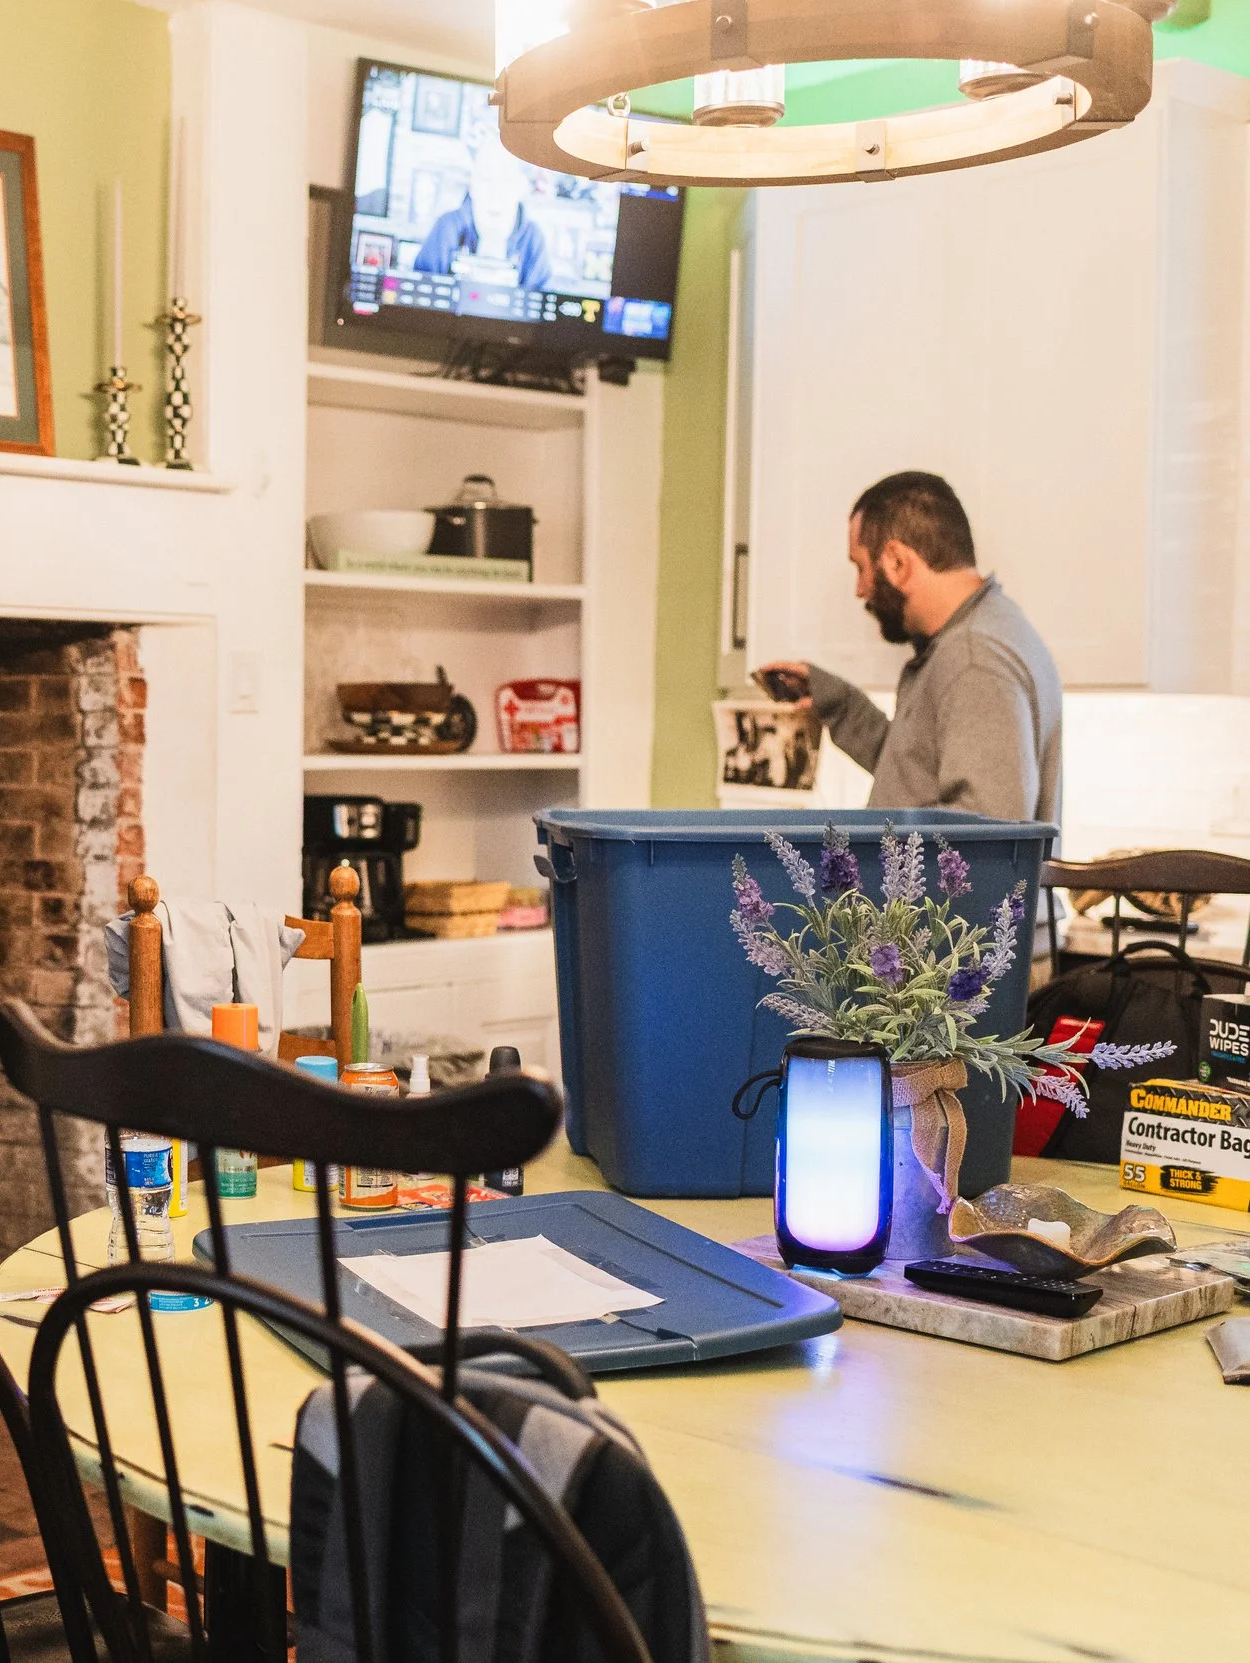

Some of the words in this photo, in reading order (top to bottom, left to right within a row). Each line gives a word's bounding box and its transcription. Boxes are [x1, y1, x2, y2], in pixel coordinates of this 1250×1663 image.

[1210, 1018, 1250, 1042] DUDE
[1209, 1036, 1249, 1057] WIPES
[1130, 1088, 1232, 1121] COMMANDER
[1128, 1116, 1216, 1148] Contractor
[1125, 1140, 1141, 1150] Heavy
[1142, 1142, 1156, 1152] Duty
[1124, 1164, 1146, 1183] 55
[1170, 1168, 1193, 1180] THICK
[1195, 1171, 1202, 1180] &
[1169, 1178, 1202, 1190] STRONG
